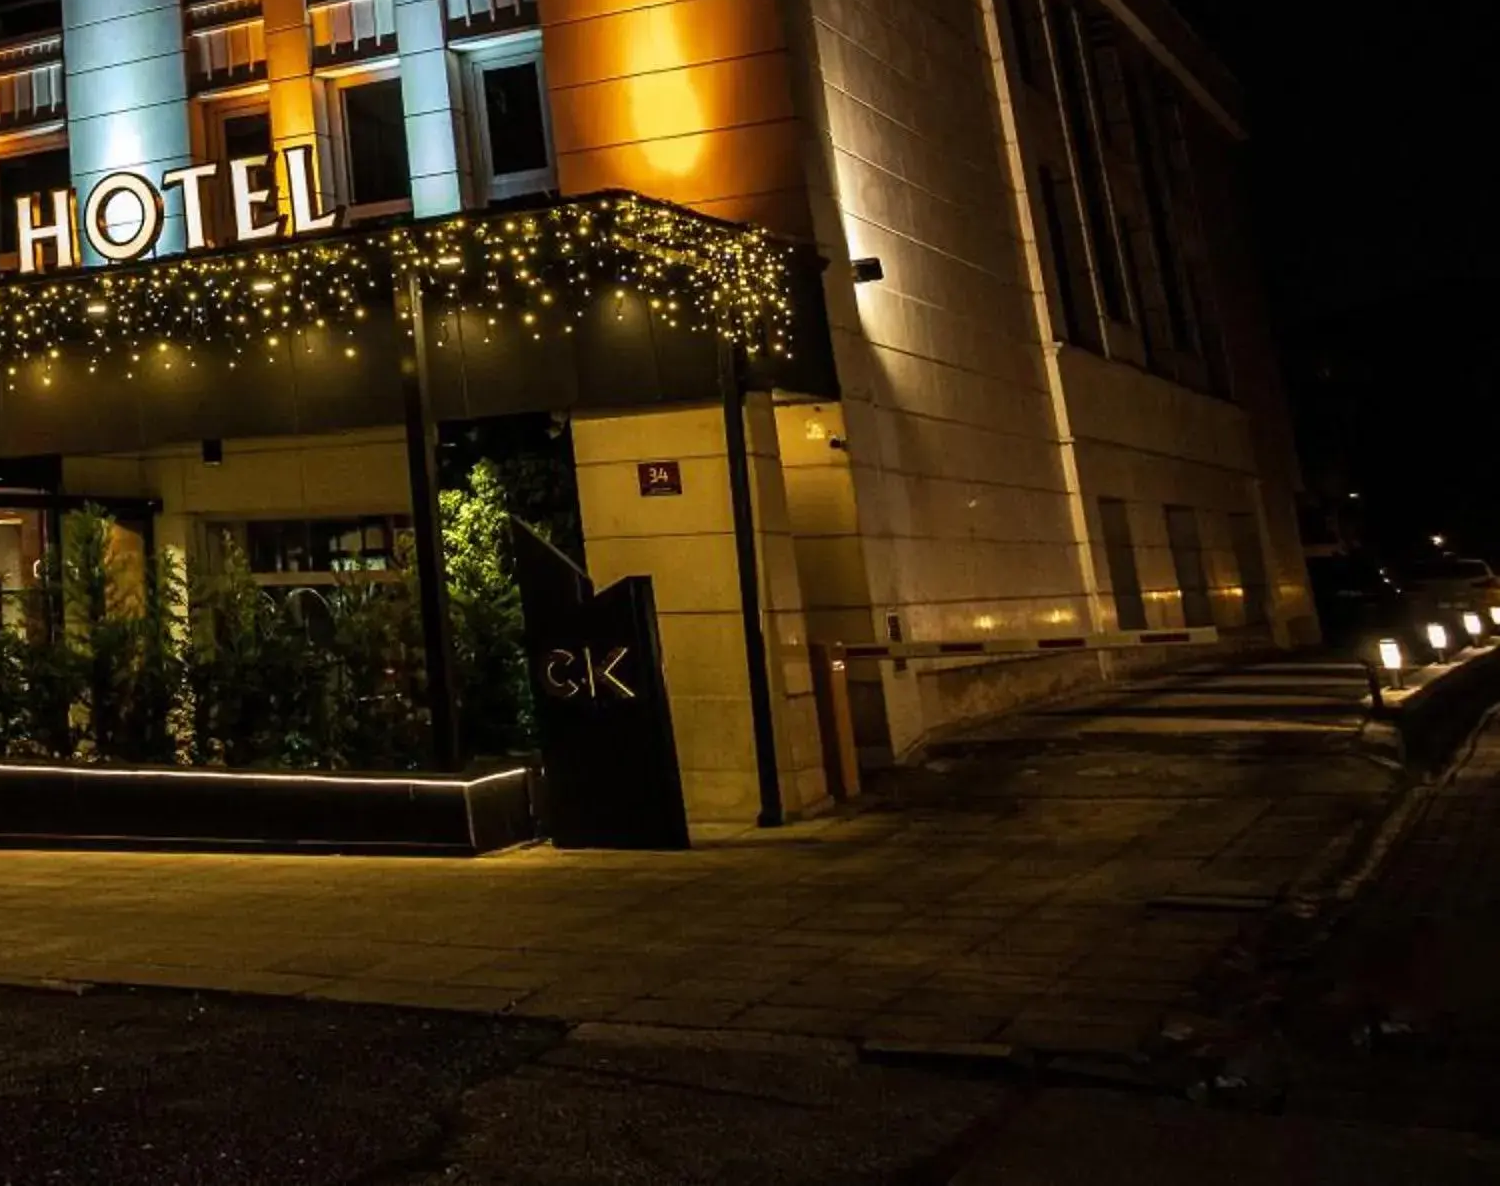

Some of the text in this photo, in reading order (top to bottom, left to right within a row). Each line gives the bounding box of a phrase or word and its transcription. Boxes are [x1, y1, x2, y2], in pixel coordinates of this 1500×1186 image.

[16, 147, 341, 273] HOTEL
[649, 467, 668, 483] 34
[545, 647, 635, 698] CK
